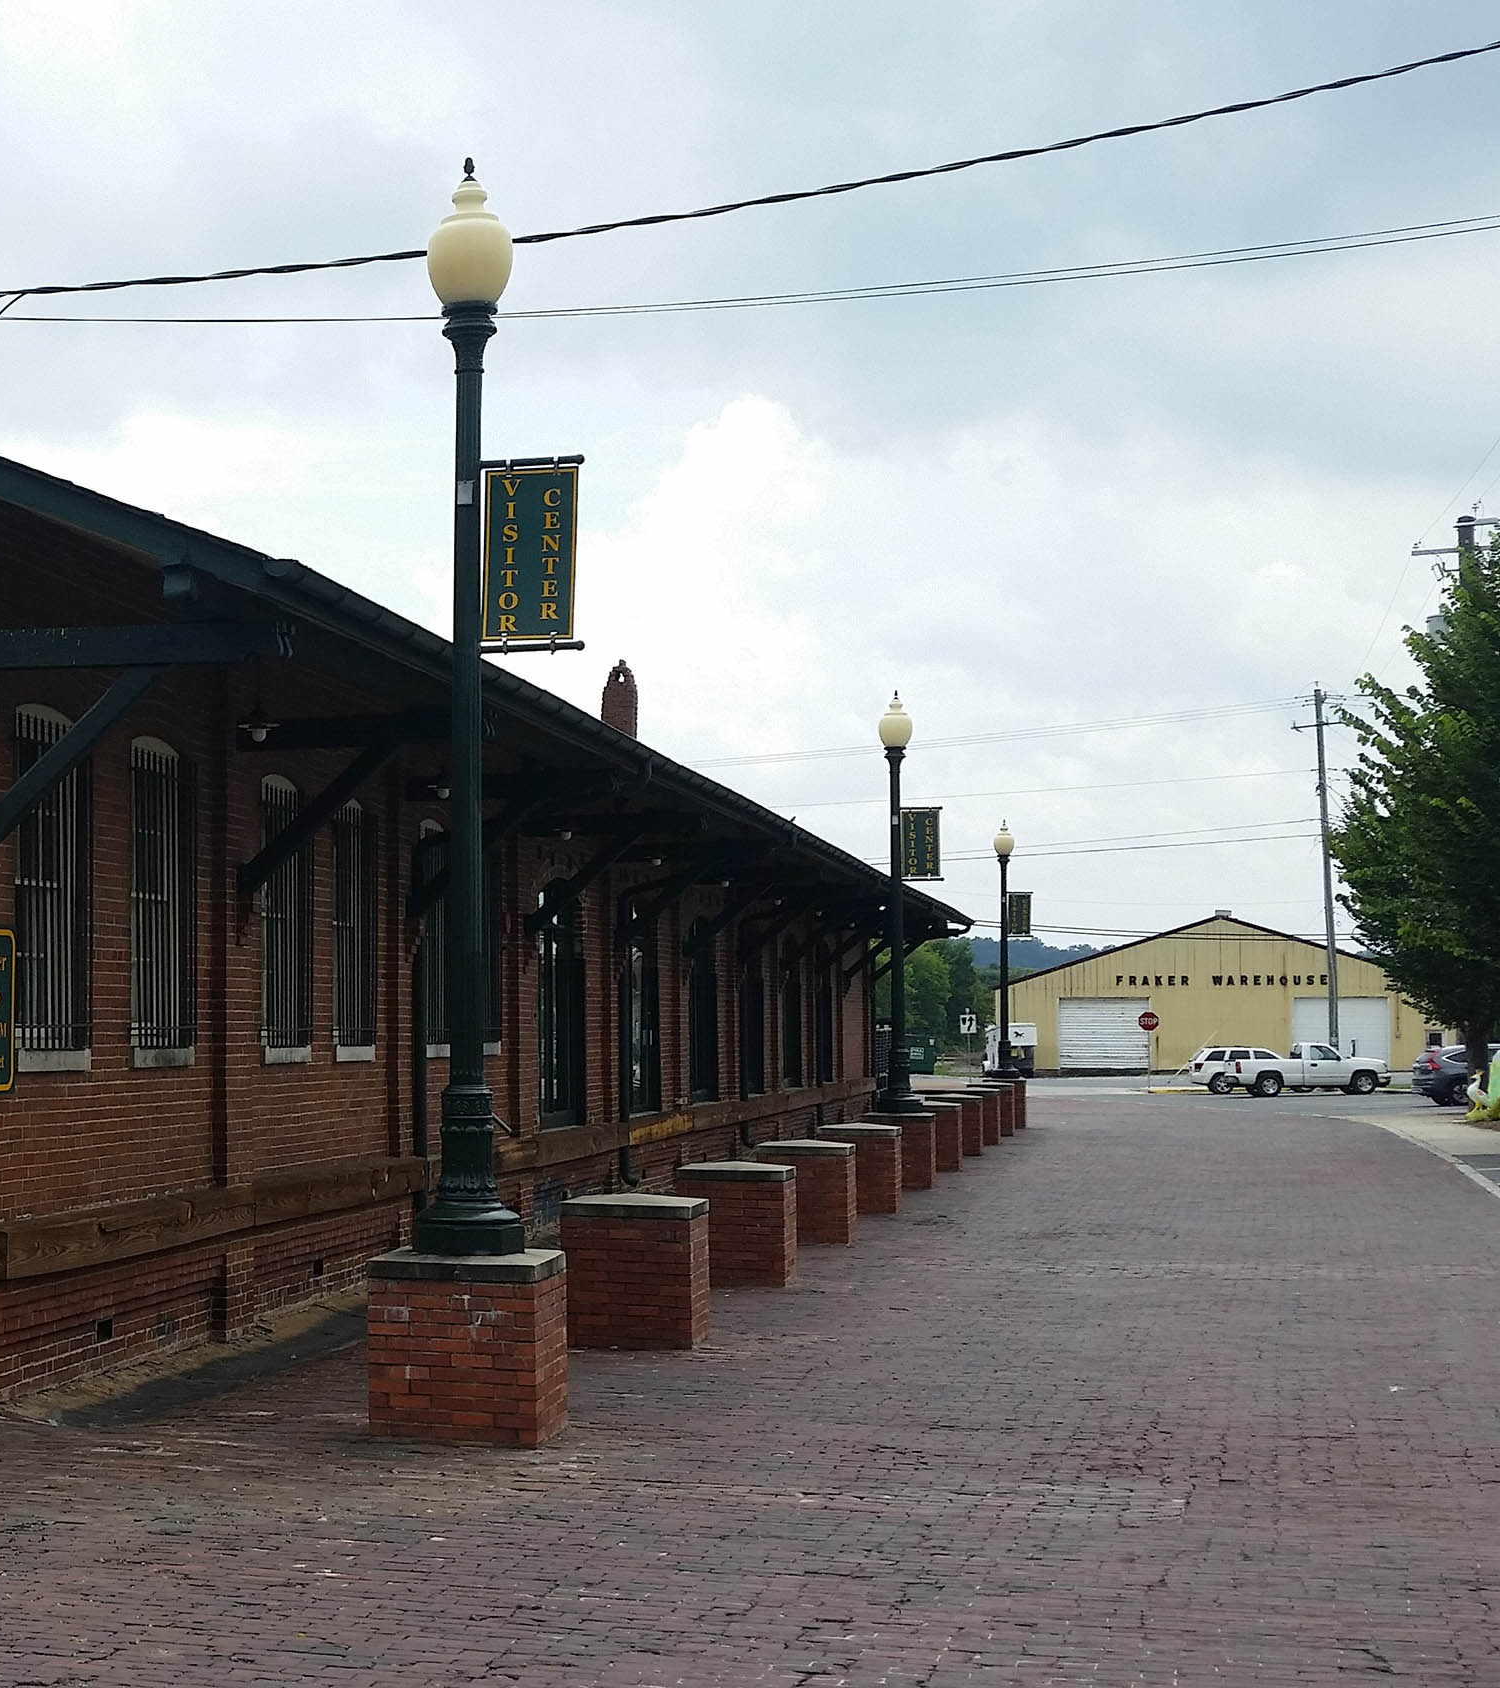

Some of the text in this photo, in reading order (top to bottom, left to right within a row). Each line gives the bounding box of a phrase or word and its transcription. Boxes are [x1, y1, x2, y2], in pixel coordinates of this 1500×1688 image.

[497, 478, 523, 632] VISITOR
[539, 488, 562, 620] CENTER
[909, 814, 918, 874] VISITOR
[925, 818, 934, 869] CENTER
[1116, 974, 1328, 986] FRAKER WAREHOUSE
[1139, 1017, 1158, 1026] STOP
